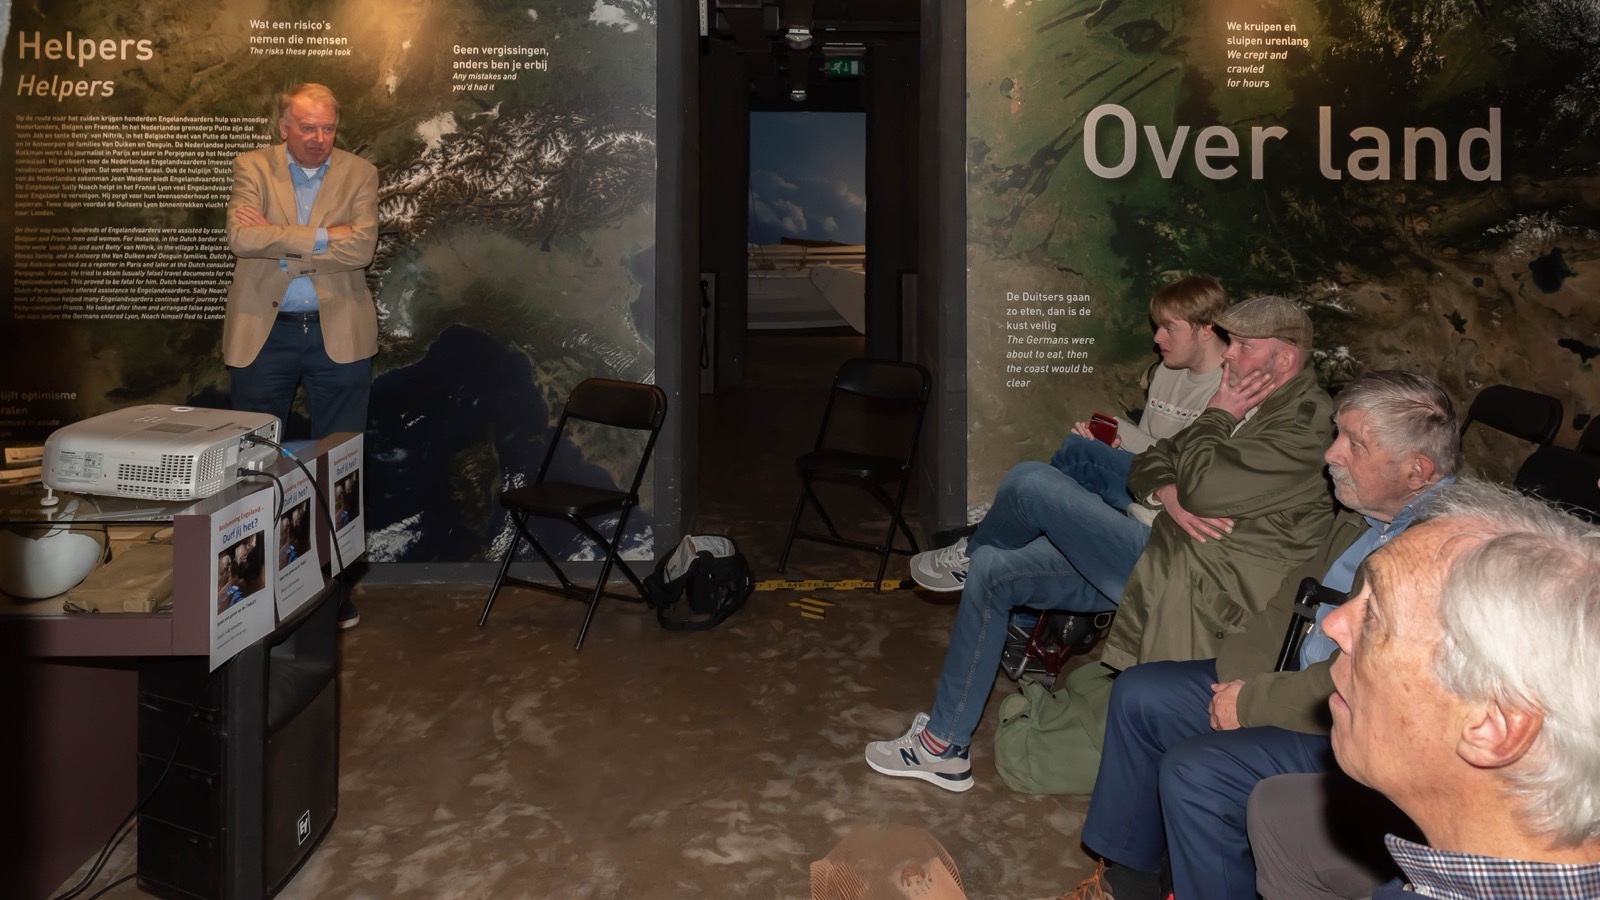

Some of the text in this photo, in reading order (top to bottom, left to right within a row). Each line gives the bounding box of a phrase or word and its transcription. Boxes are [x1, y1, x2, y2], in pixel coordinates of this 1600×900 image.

[250, 20, 269, 29] Wat
[294, 20, 331, 30] risico's
[1227, 22, 1241, 30] We
[1245, 22, 1281, 33] kruipen
[288, 35, 303, 44] die
[1227, 36, 1308, 48] sluipen urenlang
[20, 31, 153, 67] Helpers
[308, 48, 332, 57] people
[453, 45, 548, 57] Geen vergissingen,
[1228, 50, 1288, 61] We crept and
[453, 60, 547, 71] anders ben je erbij
[1227, 65, 1264, 73] crawled
[452, 72, 467, 81] Any
[17, 74, 114, 102] Helpers
[452, 84, 472, 92] you'd
[1227, 78, 1269, 87] for hours
[1083, 103, 1501, 181] Over land
[1007, 292, 1090, 303] De Duitsers gaan
[1020, 308, 1044, 316] eten,
[1048, 307, 1065, 315] dan
[1069, 307, 1076, 315] is
[1079, 307, 1091, 315] de
[1007, 321, 1056, 332] kust veilig
[1008, 335, 1023, 344] The
[1027, 336, 1068, 344] Germans
[1007, 350, 1033, 358] about
[1047, 351, 1063, 359] eat,
[1067, 350, 1088, 358] then
[1007, 364, 1021, 372] the
[1052, 364, 1080, 373] would
[1082, 364, 1093, 373] be
[1007, 379, 1030, 387] clear
[22, 390, 76, 402] optimisme
[223, 529, 235, 544] Durf
[243, 518, 258, 532] het?
[898, 747, 921, 767] N
